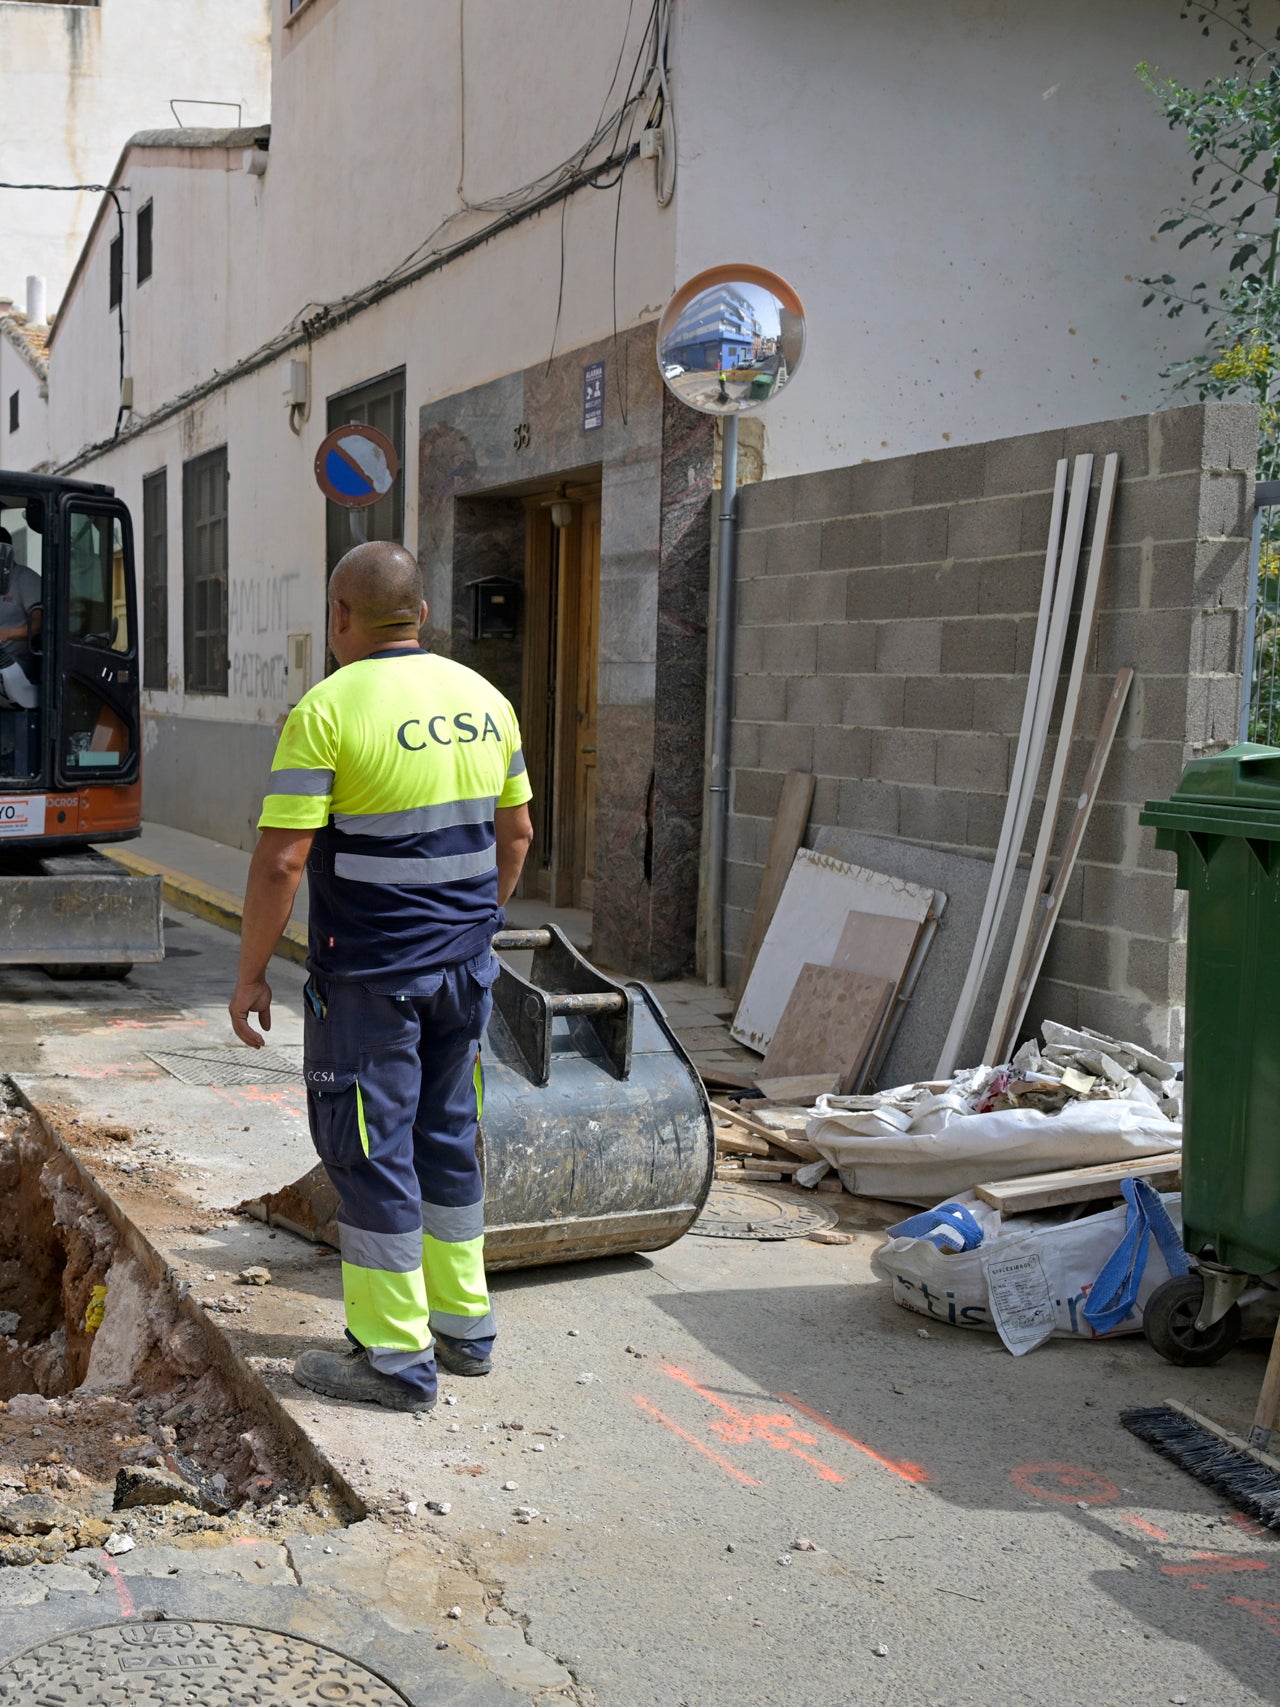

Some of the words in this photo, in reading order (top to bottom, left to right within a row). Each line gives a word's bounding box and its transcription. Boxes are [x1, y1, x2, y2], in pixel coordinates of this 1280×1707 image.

[513, 423, 530, 450] 38
[397, 712, 502, 751] CCSA
[307, 1070, 335, 1083] CCSA
